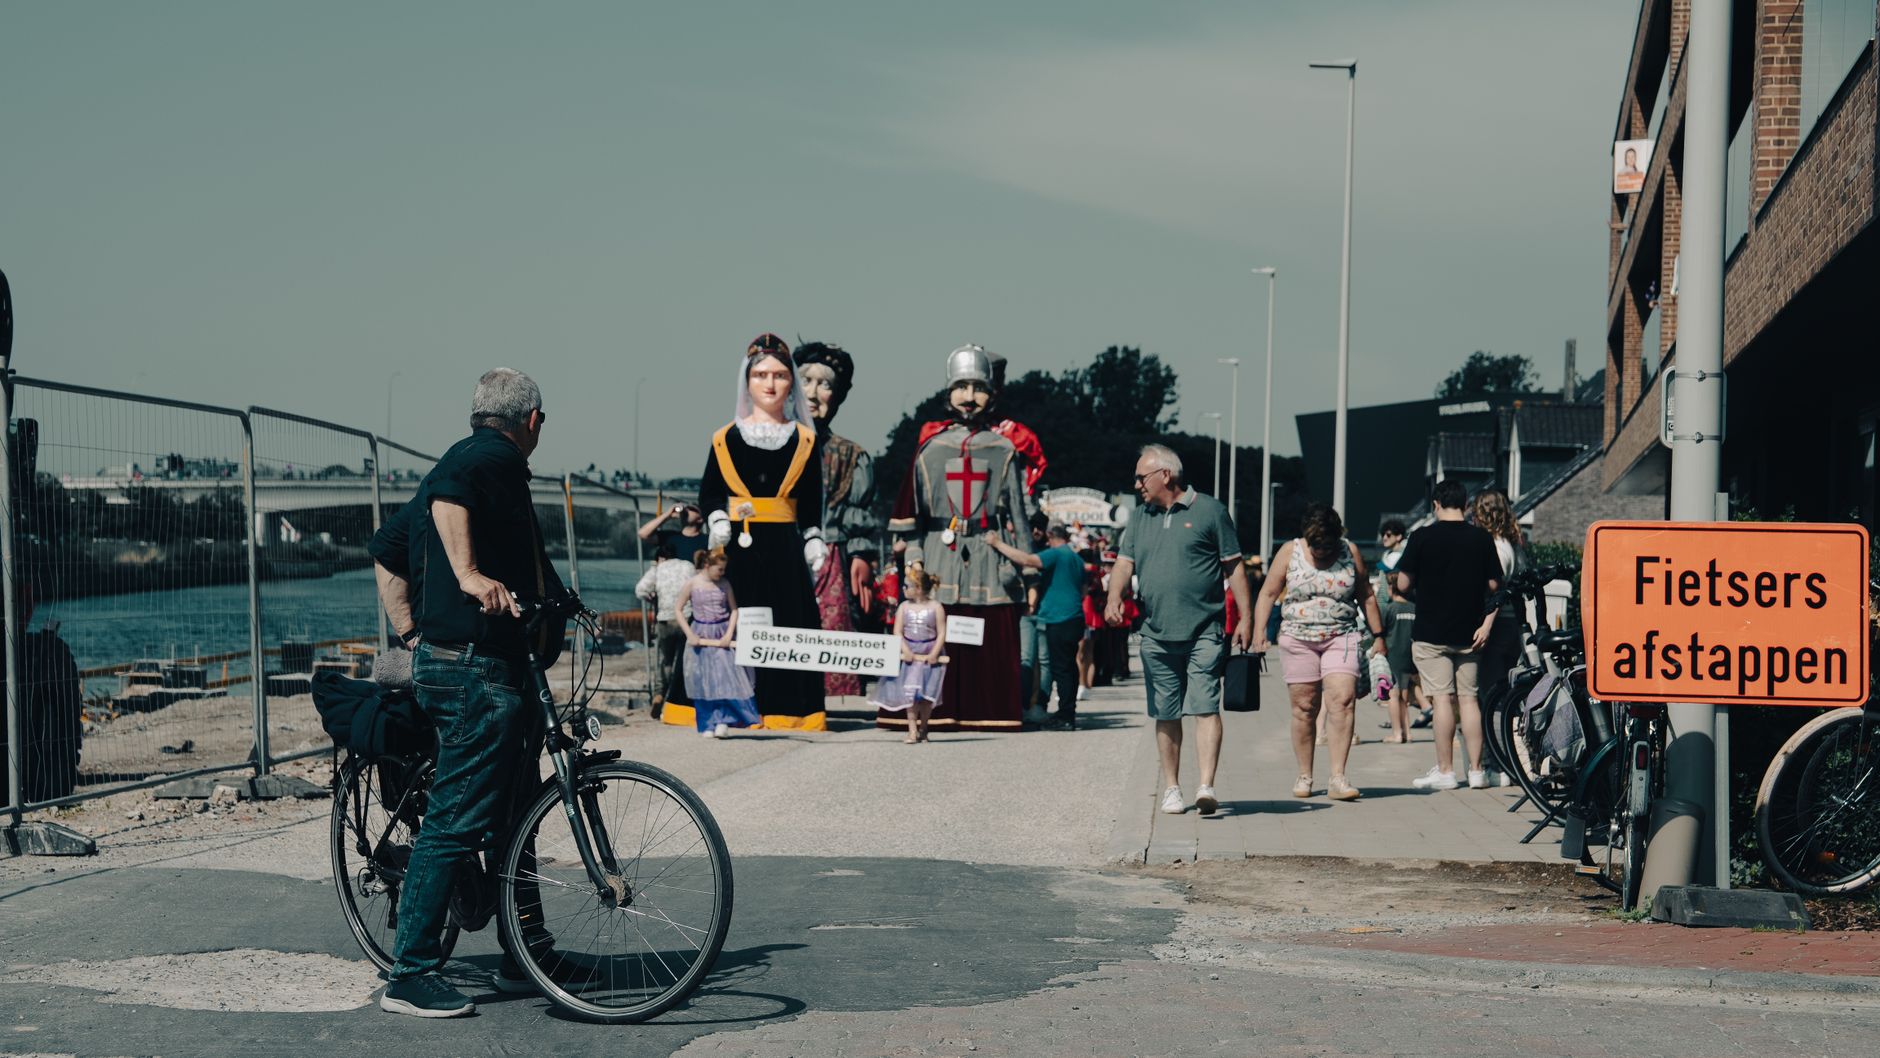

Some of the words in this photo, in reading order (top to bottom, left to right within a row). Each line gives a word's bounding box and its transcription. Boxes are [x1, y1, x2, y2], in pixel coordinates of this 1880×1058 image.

[1635, 556, 1827, 609] Fietsers
[750, 646, 811, 664] Sjieke
[818, 650, 886, 670] Dinges
[751, 630, 790, 643] 68ste
[795, 633, 887, 650] Sinksenstoet
[1613, 630, 1847, 696] afstappen
